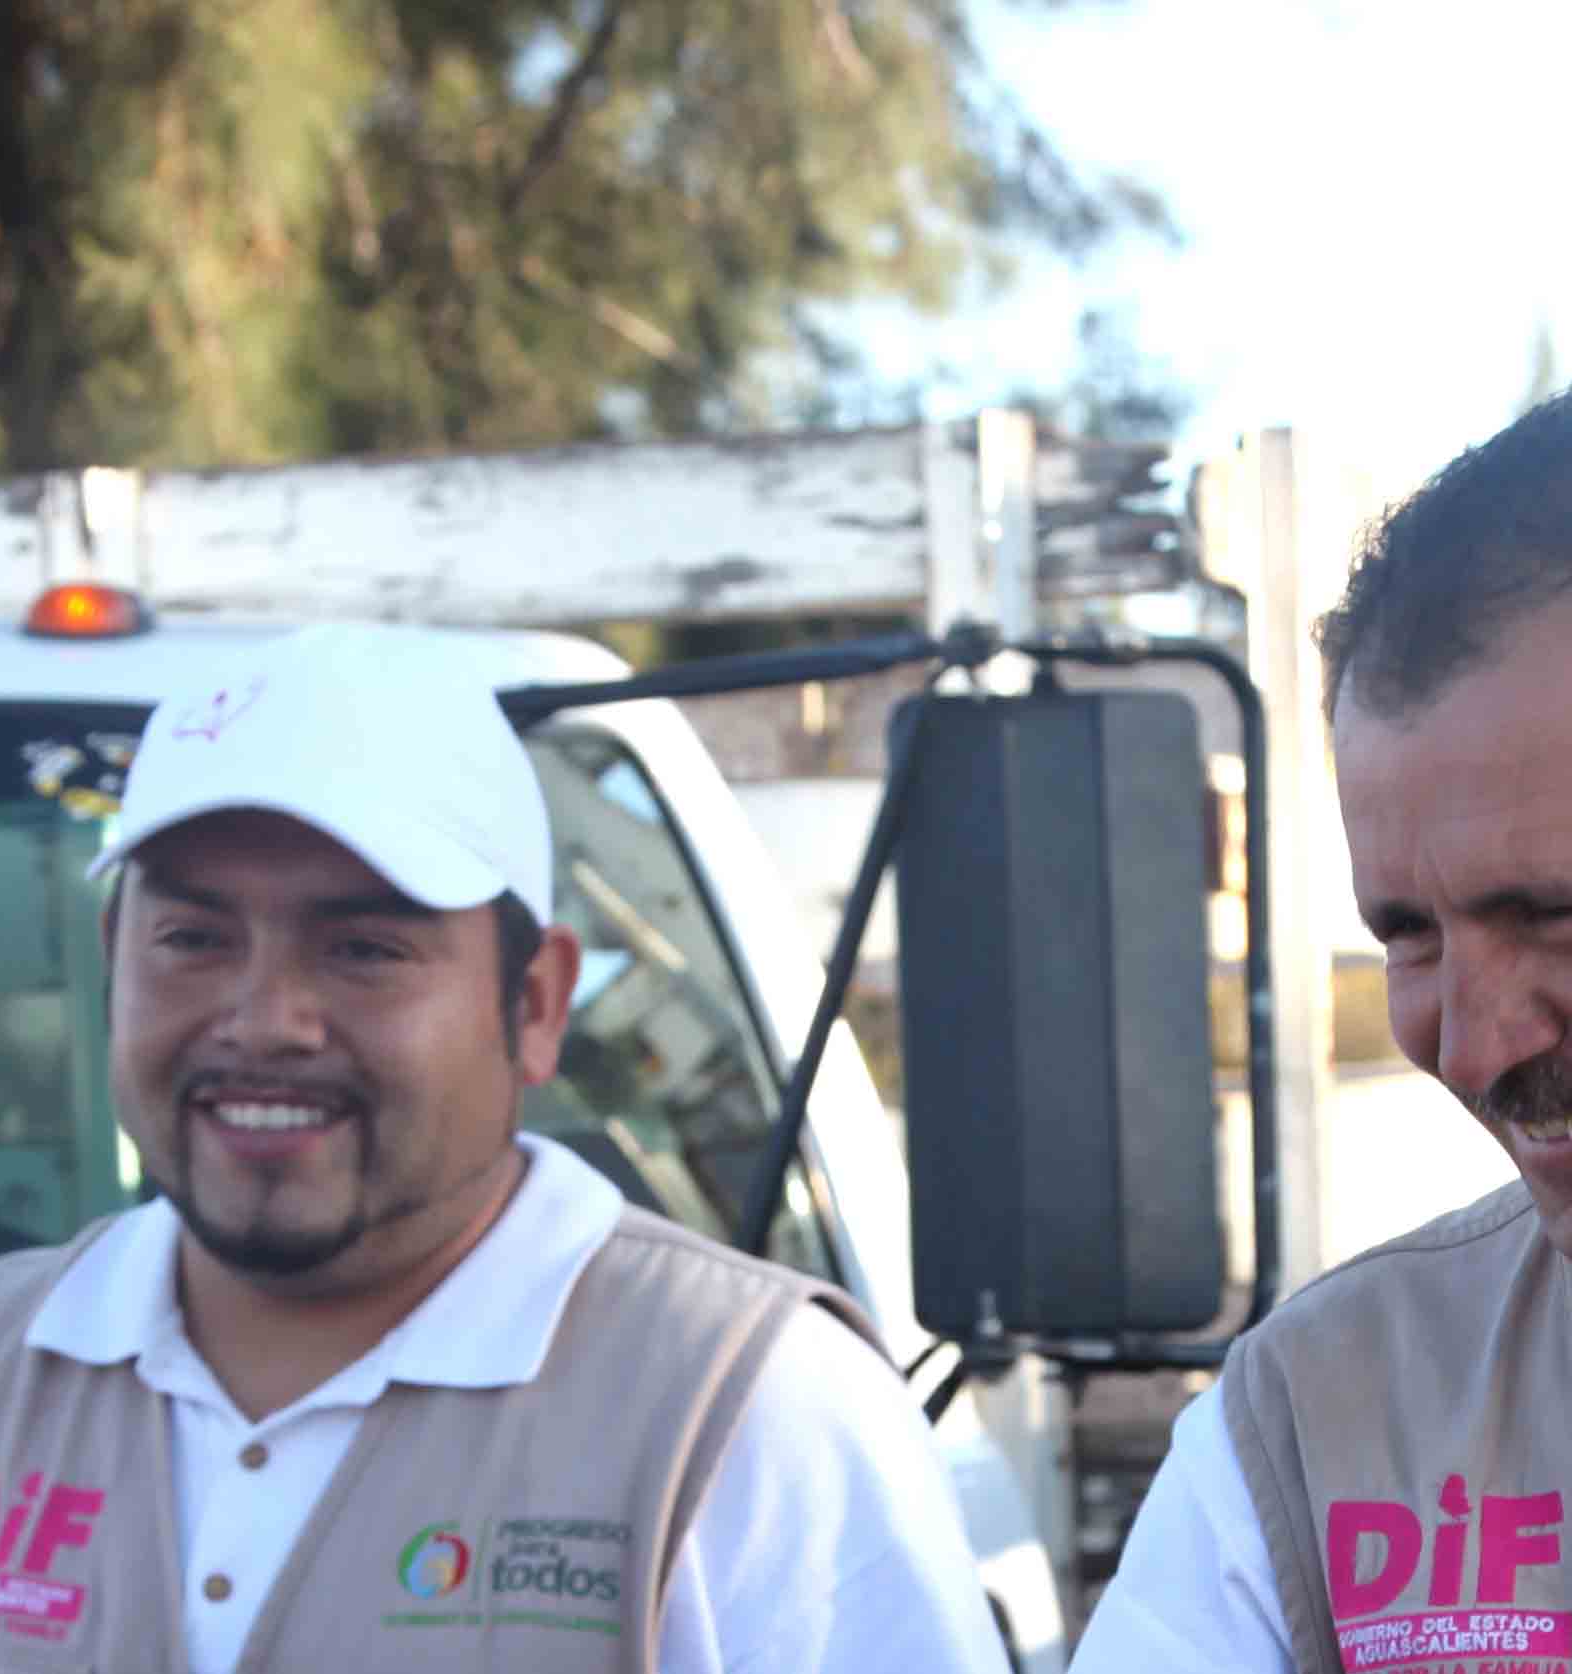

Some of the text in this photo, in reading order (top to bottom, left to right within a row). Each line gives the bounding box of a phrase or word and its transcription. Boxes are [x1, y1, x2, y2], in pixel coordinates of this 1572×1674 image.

[491, 1555, 621, 1601] todos
[1469, 1614, 1556, 1634] ESTADO
[1354, 1630, 1530, 1668] AGUASCALIENTES
